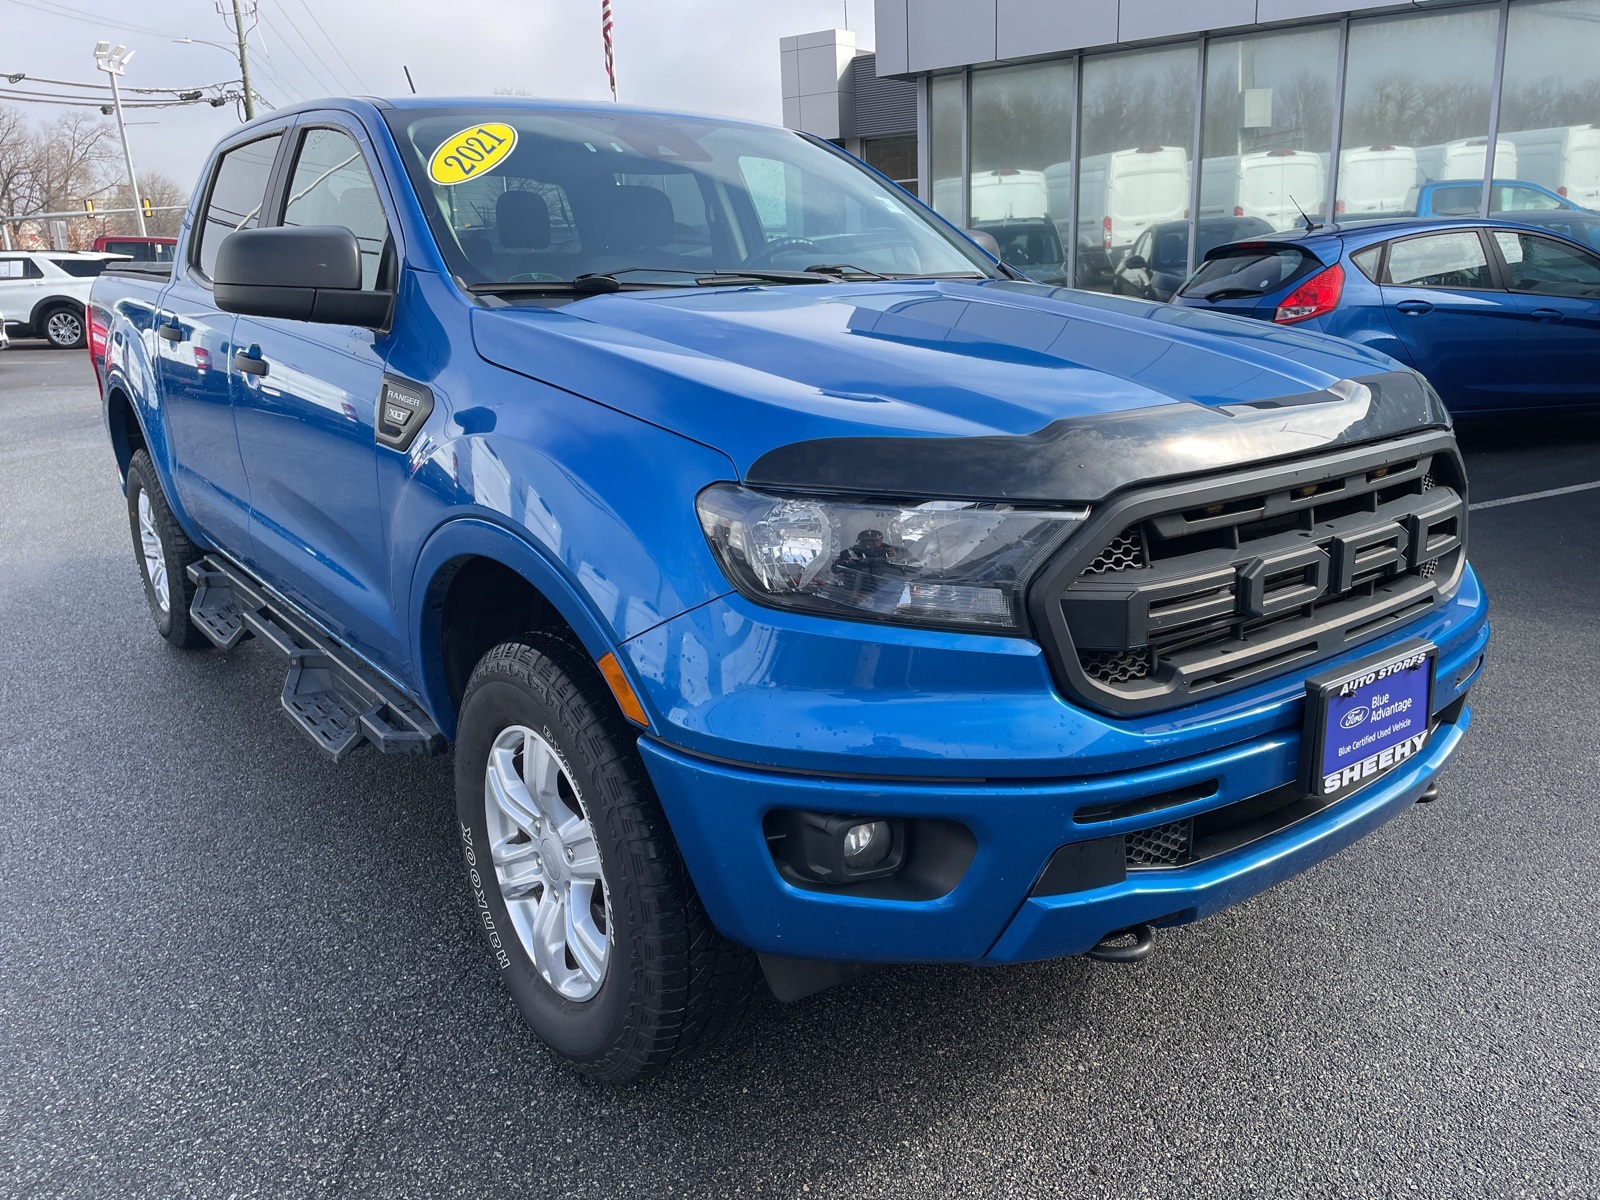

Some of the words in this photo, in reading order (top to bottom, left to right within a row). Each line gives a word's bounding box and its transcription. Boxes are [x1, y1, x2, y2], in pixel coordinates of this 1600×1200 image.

[444, 128, 507, 175] 2021
[387, 390, 420, 407] RANGER
[388, 408, 407, 421] XLT
[1126, 502, 1464, 648] FORD
[1339, 673, 1376, 697] AUTO
[1370, 697, 1412, 724] Advantage
[1371, 693, 1390, 709] Blue
[1345, 708, 1365, 727] Ford
[1338, 744, 1352, 757] Blue
[1352, 731, 1376, 750] Certified
[1377, 726, 1392, 740] Used
[1392, 717, 1412, 733] Vehicle
[1323, 731, 1428, 795] SHEEHY
